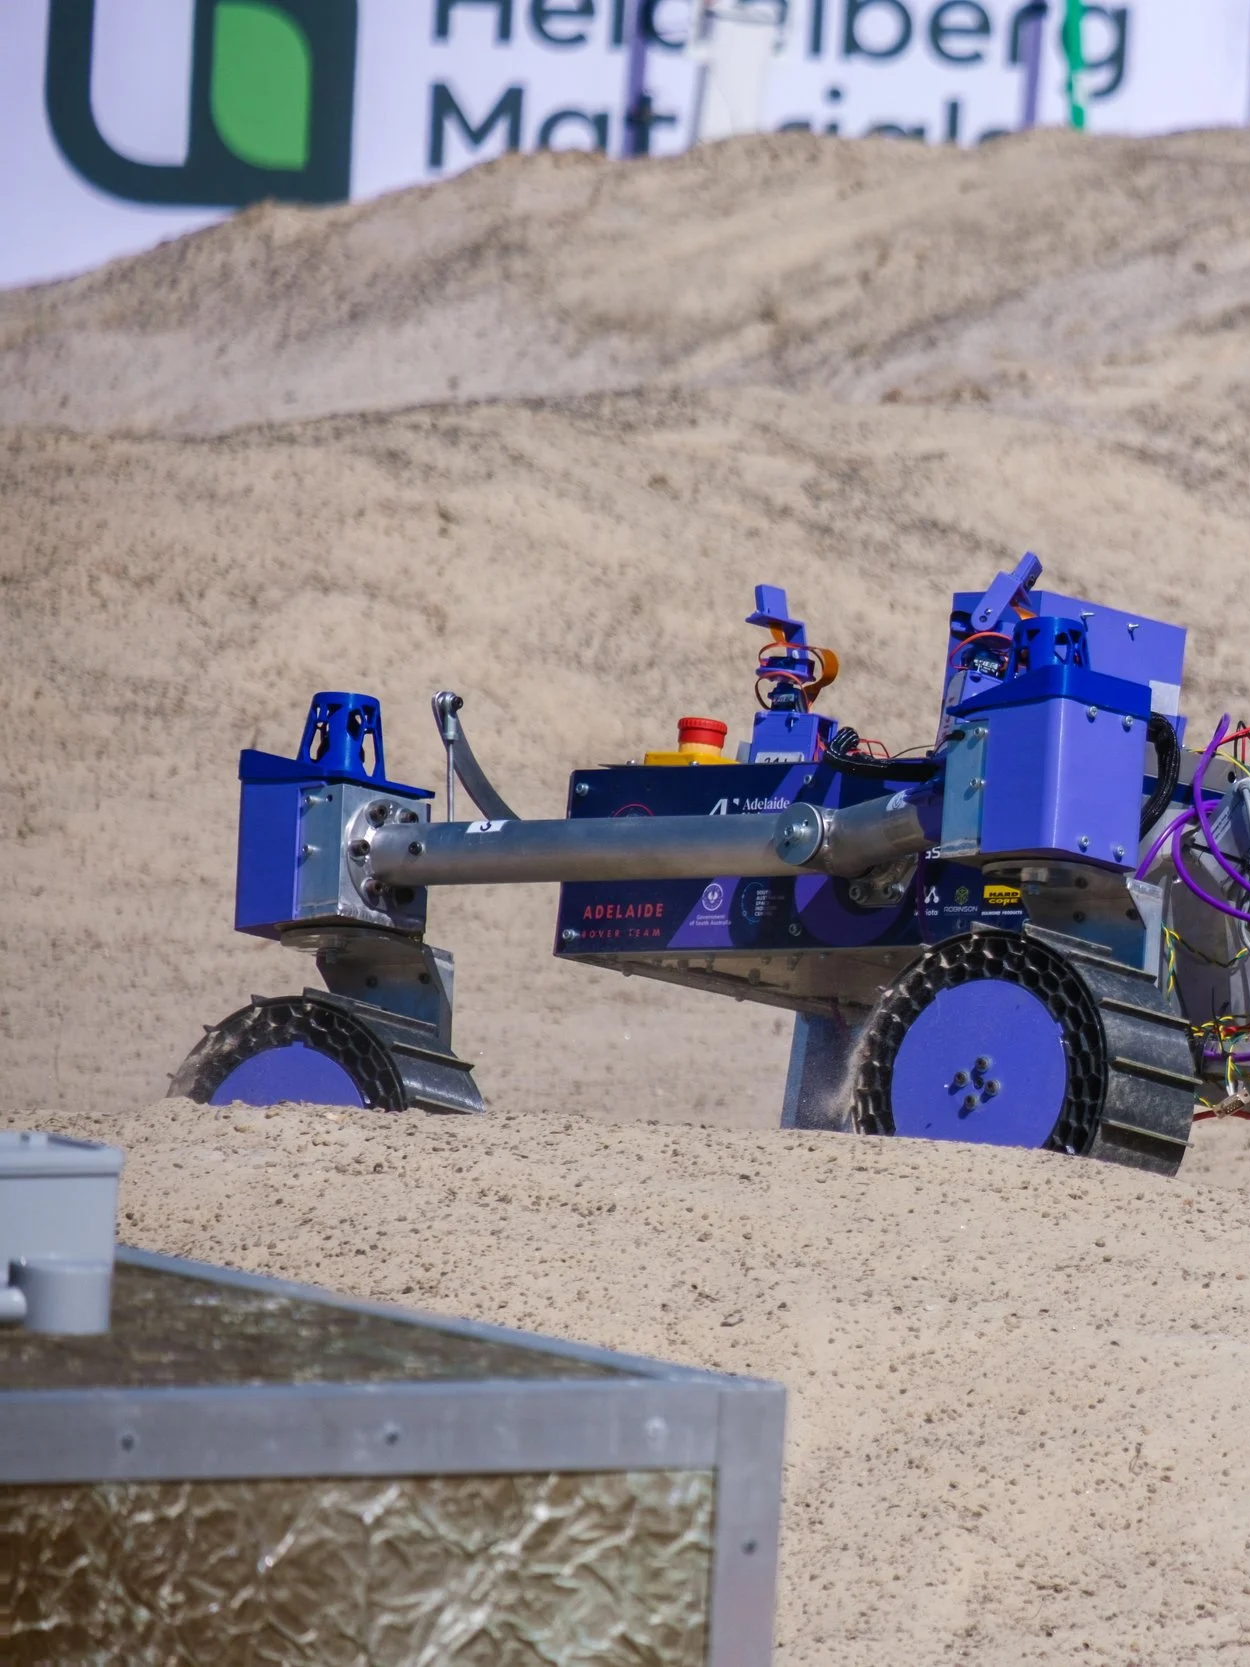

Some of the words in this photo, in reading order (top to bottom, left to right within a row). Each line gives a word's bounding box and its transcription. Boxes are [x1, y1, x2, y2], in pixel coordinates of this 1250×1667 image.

[742, 797, 790, 811] Adelaide
[988, 898, 1019, 906] CORE
[583, 903, 665, 920] ADELAIDE
[628, 927, 661, 937] TEAM
